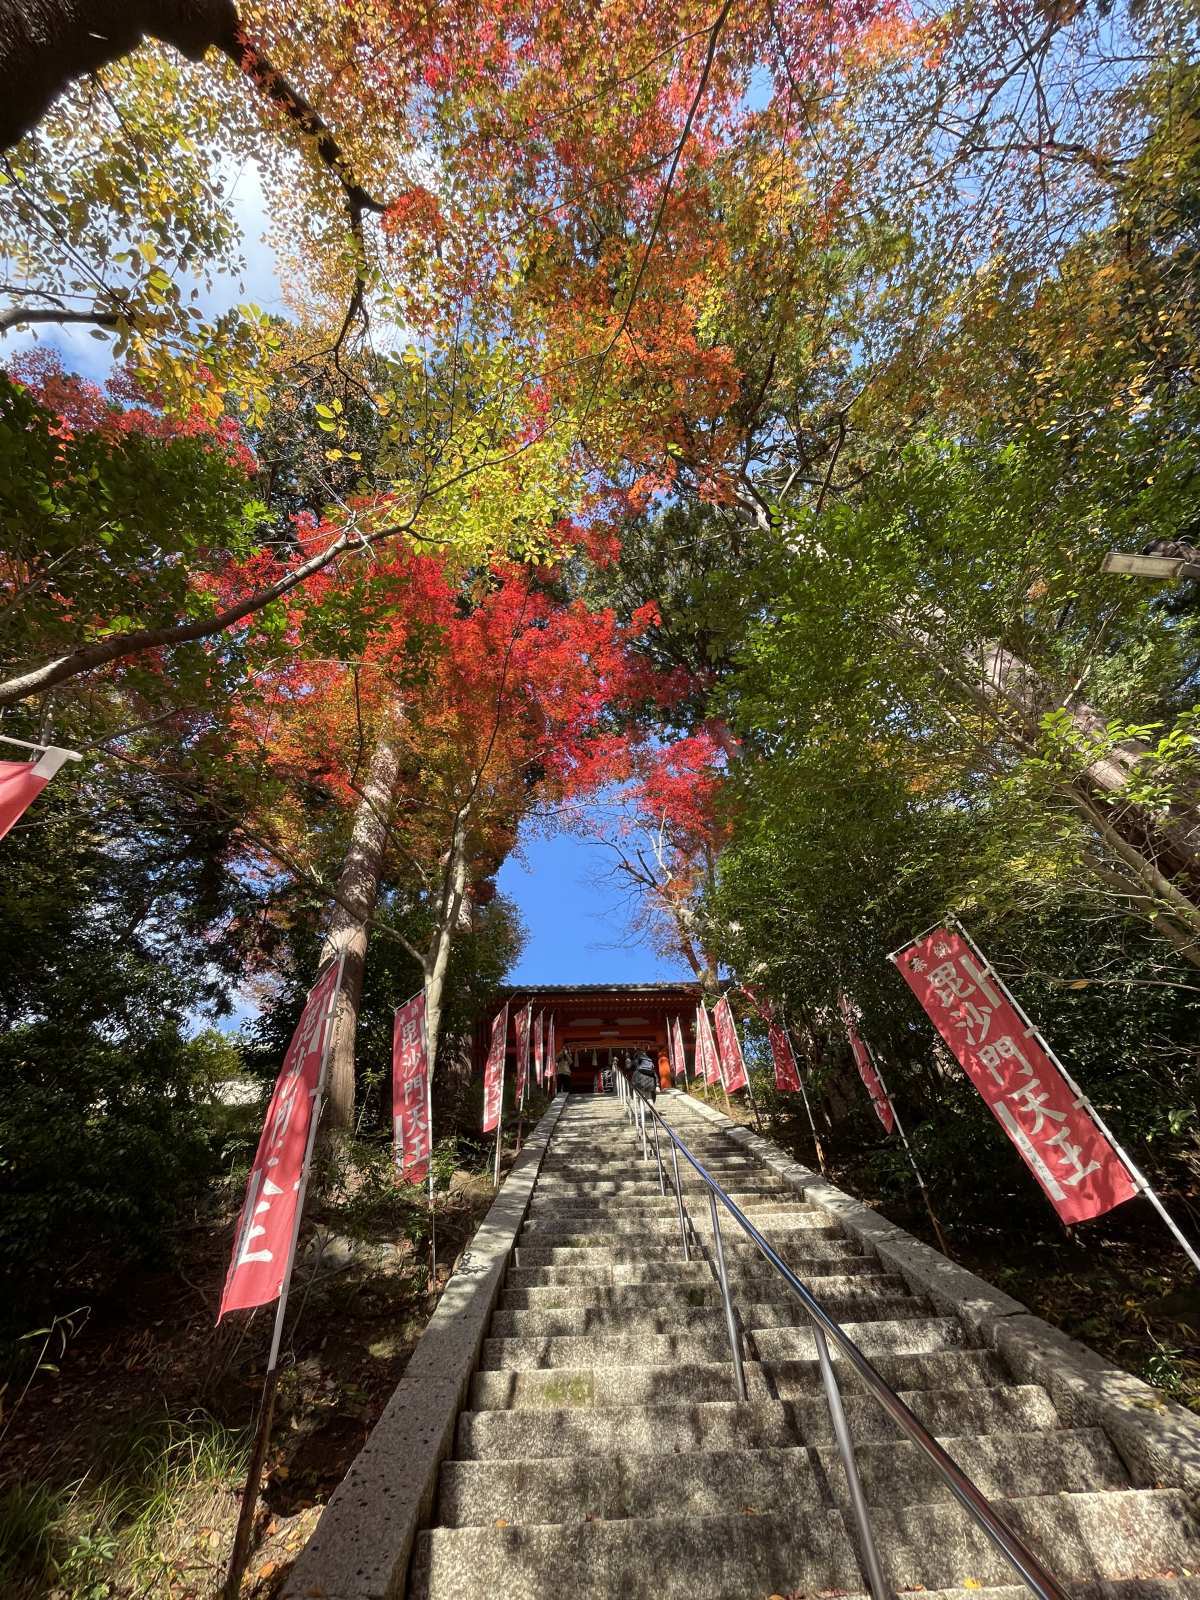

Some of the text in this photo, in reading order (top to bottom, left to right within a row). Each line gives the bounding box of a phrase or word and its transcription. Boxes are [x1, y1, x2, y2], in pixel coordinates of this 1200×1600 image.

[401, 1019, 430, 1168] 毘沙門天王
[925, 961, 1101, 1187] 毘沙門天王
